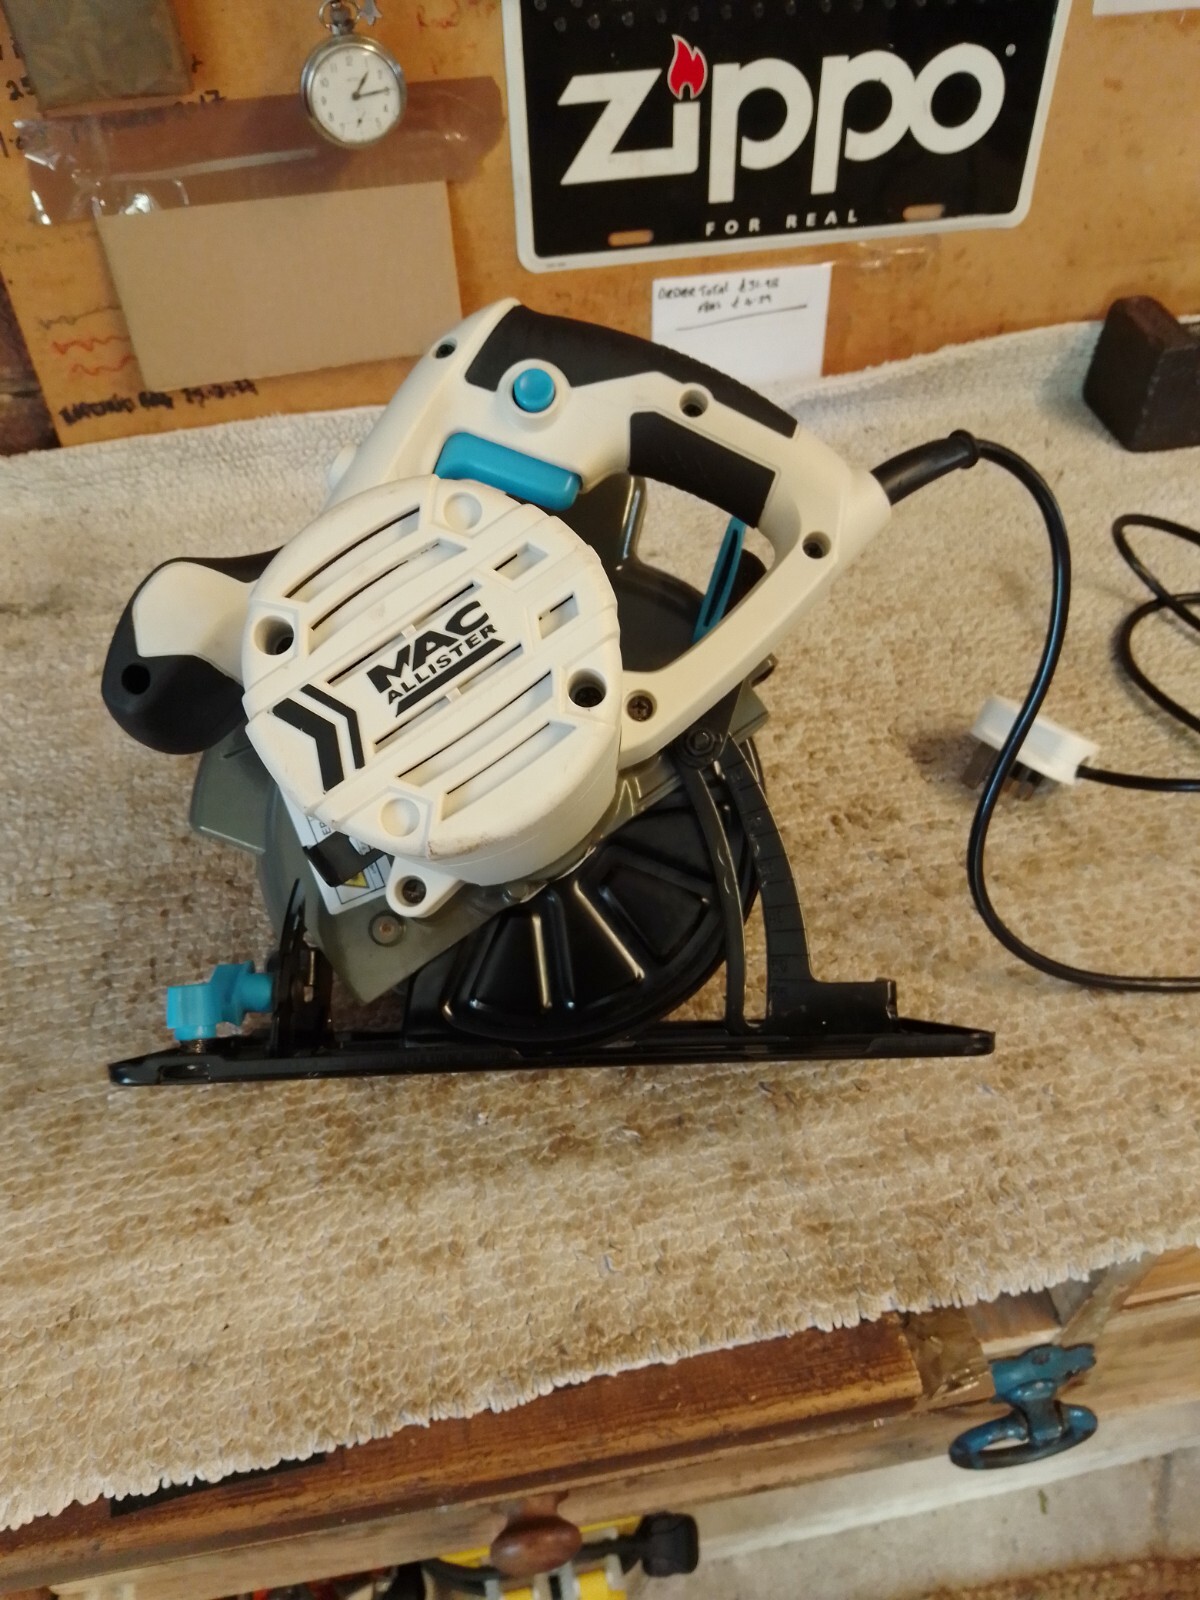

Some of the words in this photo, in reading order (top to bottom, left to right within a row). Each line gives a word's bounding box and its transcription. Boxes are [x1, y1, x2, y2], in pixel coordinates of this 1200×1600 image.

[705, 217, 762, 237] FOR
[786, 209, 860, 231] REAL
[366, 600, 490, 694] MAC
[387, 623, 499, 705] ALLISTER
